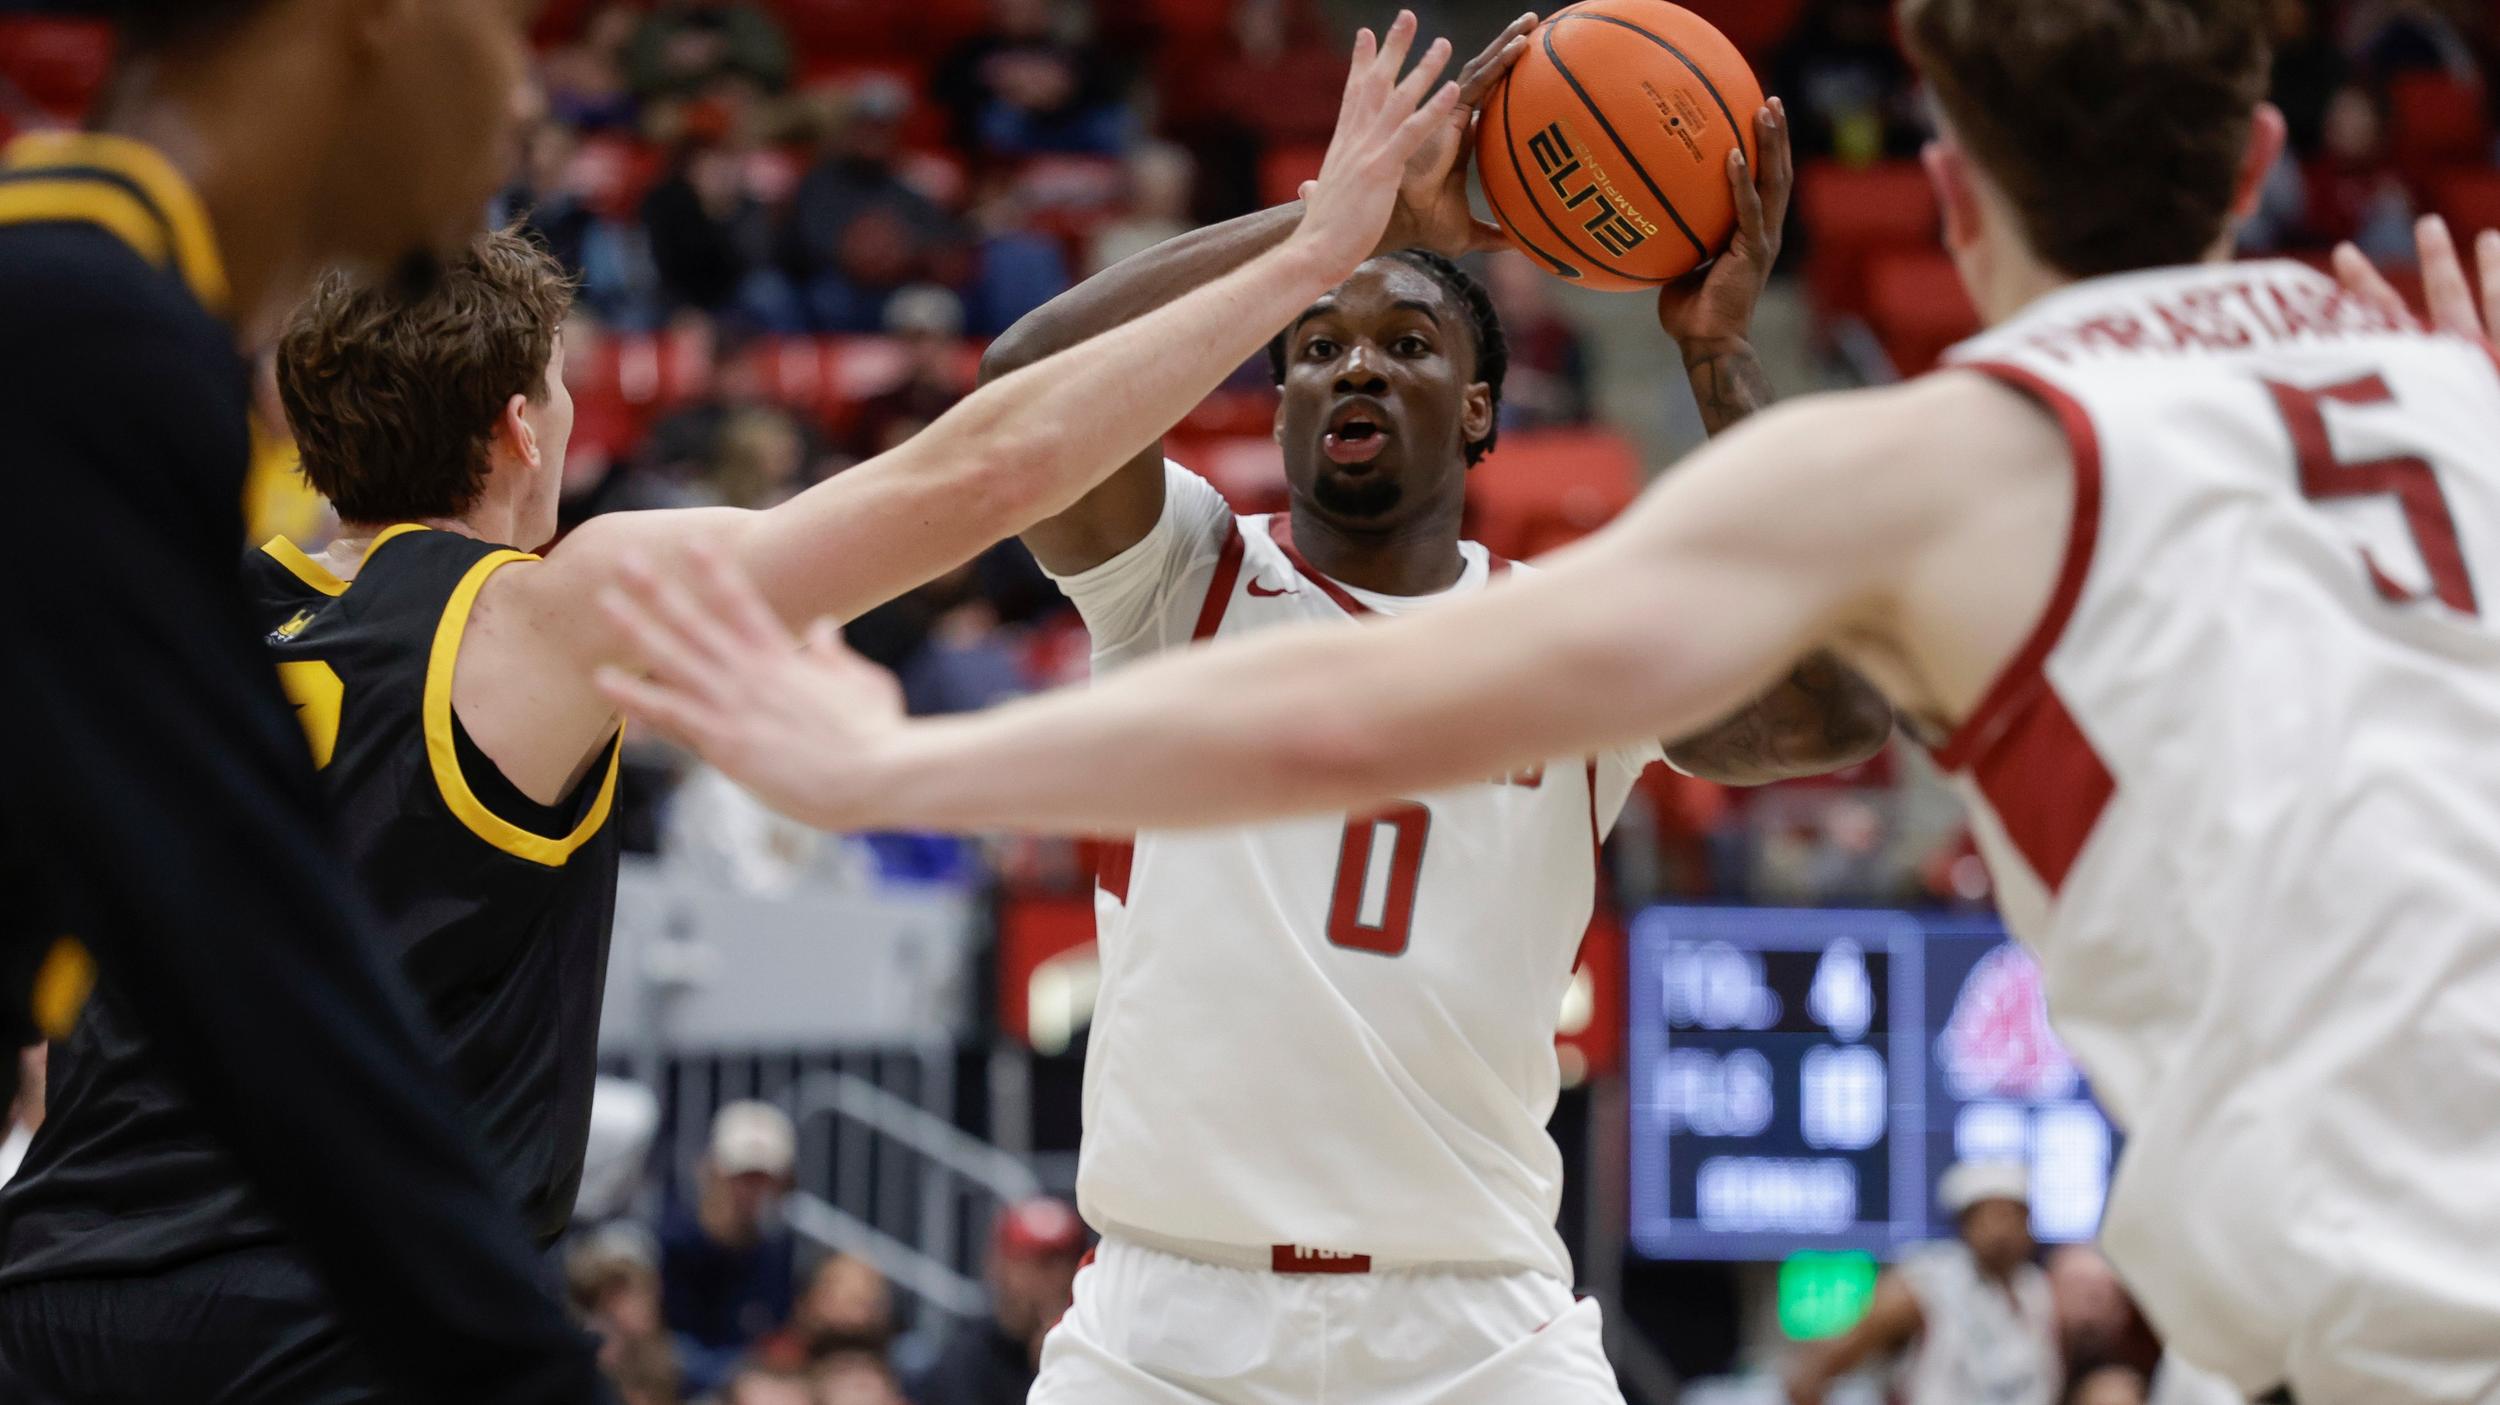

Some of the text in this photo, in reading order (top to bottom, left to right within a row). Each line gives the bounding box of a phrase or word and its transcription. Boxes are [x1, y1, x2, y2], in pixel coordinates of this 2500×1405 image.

[1527, 122, 1648, 257] ELITE
[2263, 374, 2479, 616] 5
[1327, 799, 1432, 959] 0
